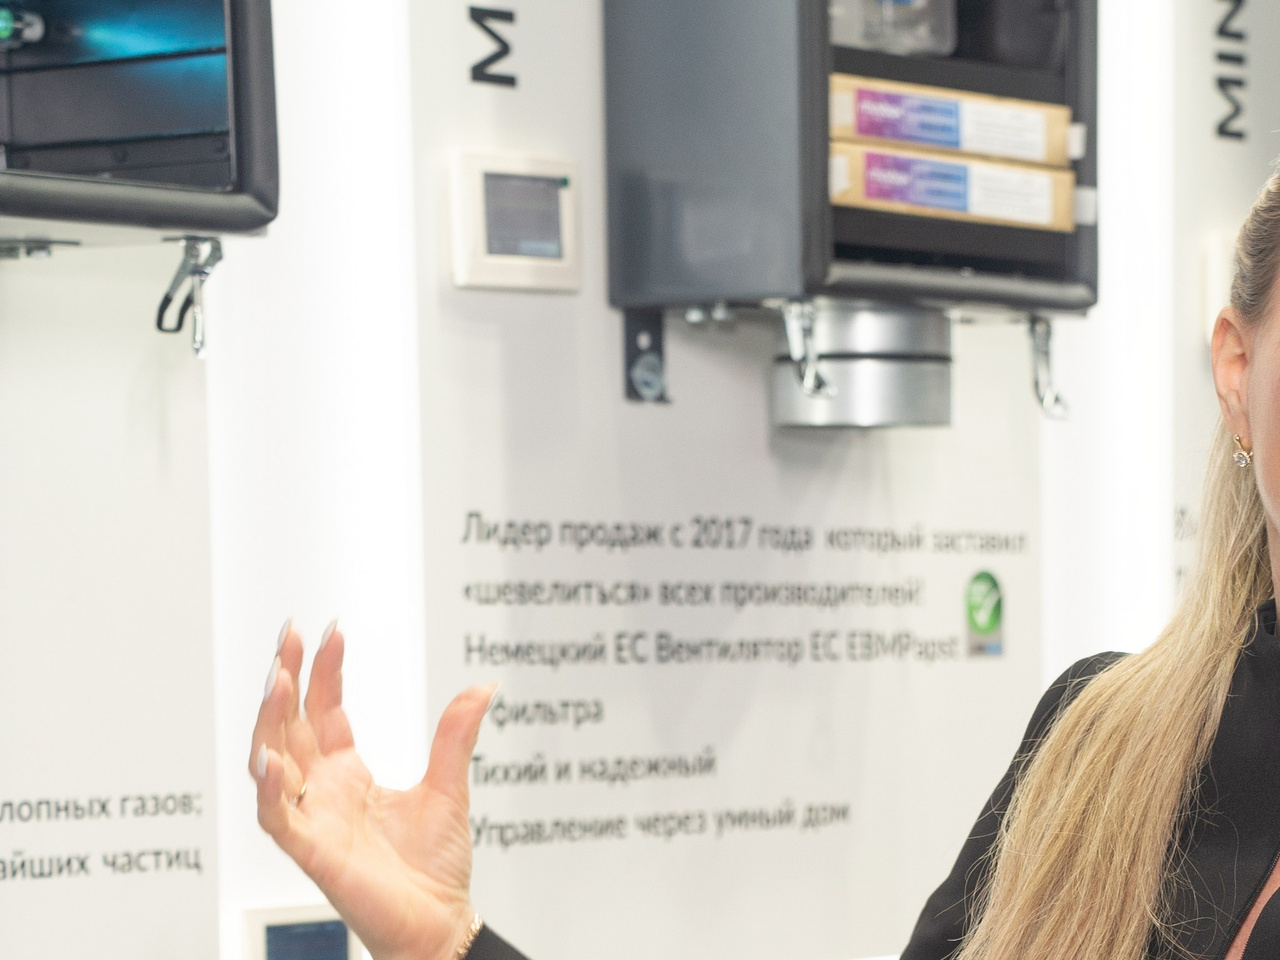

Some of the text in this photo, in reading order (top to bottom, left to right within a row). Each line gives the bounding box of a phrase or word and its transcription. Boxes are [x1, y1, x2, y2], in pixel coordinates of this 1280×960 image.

[469, 6, 516, 88] M
[461, 510, 1027, 554] Лидер продаж с 2017 года который заставил
[659, 582, 714, 606] всех
[465, 635, 606, 668] Немецкий
[655, 631, 804, 665] Вентилятор
[555, 762, 571, 781] и
[471, 799, 850, 850] Управление через умный дом
[102, 849, 203, 874] частиц
